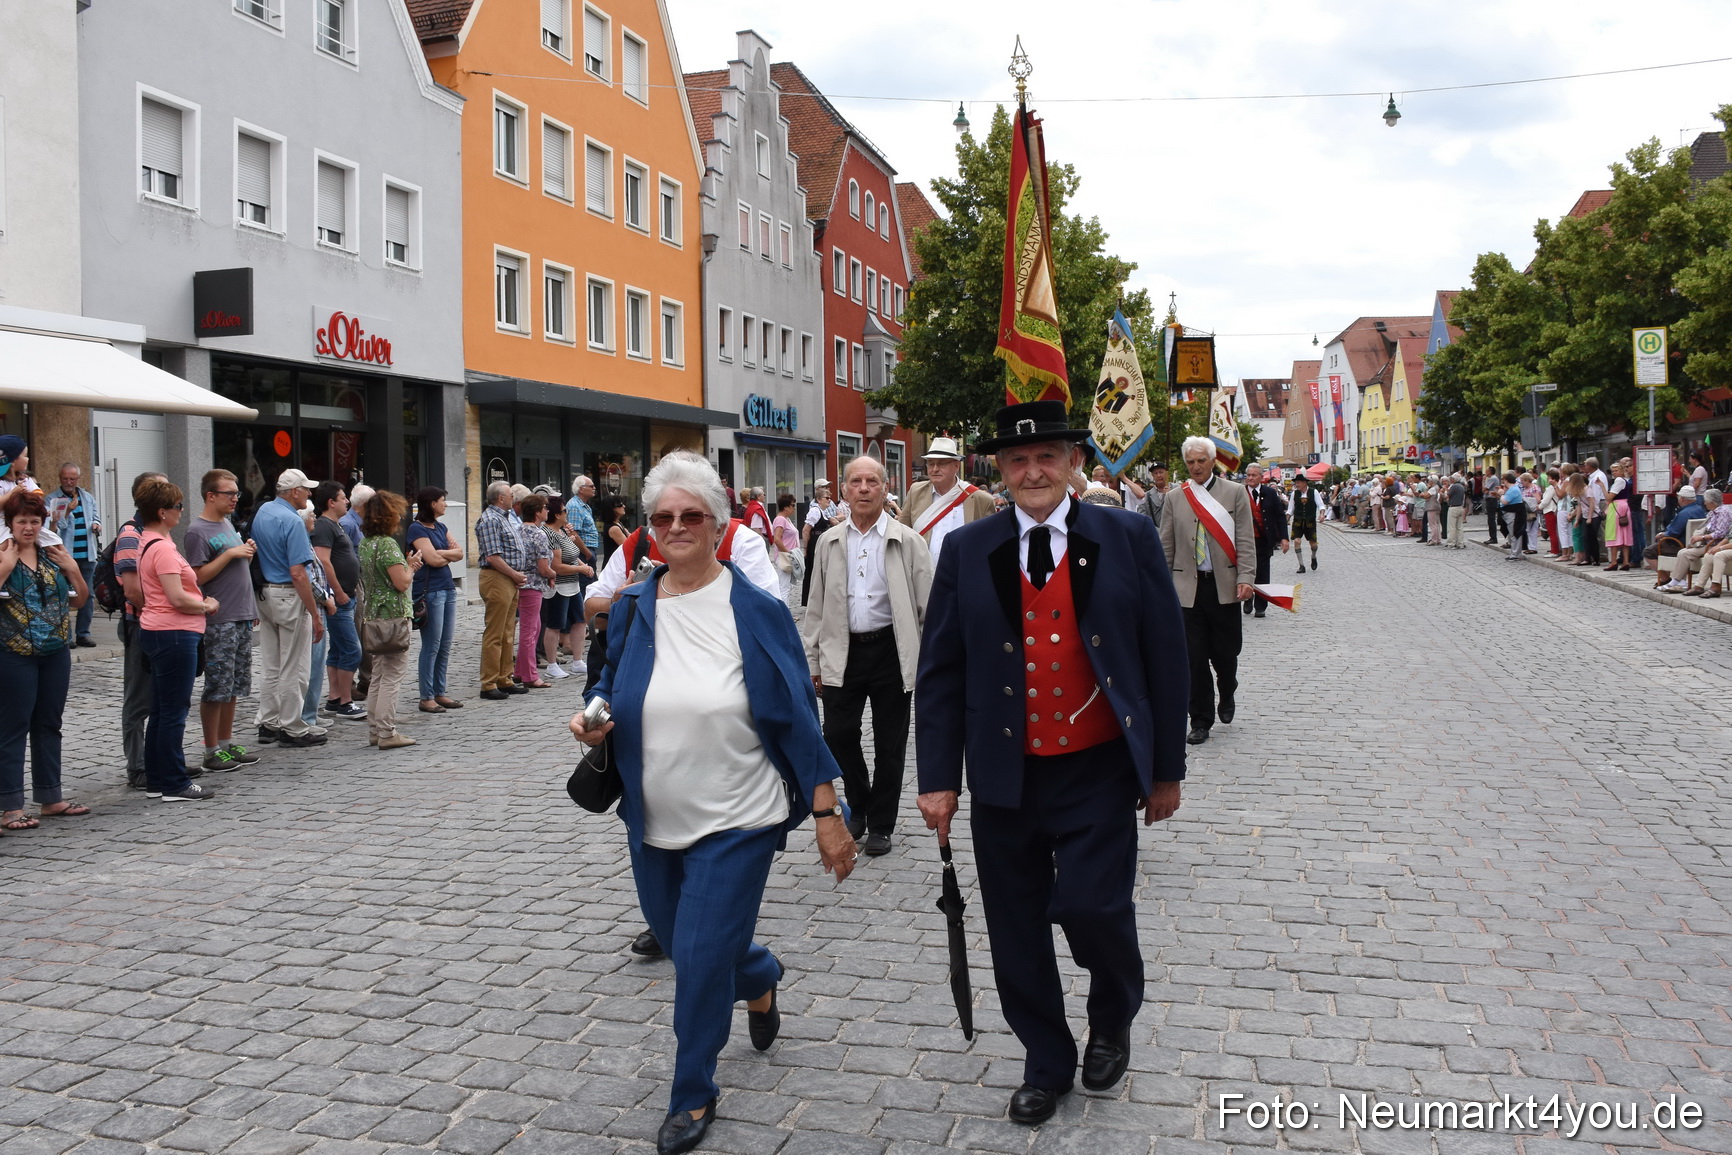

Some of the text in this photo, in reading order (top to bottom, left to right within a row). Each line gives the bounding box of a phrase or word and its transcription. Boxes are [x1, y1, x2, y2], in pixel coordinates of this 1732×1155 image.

[200, 310, 242, 329] s.Oliver
[316, 311, 394, 365] s.Oliver
[130, 419, 138, 428] 29
[746, 393, 788, 430] Eilles
